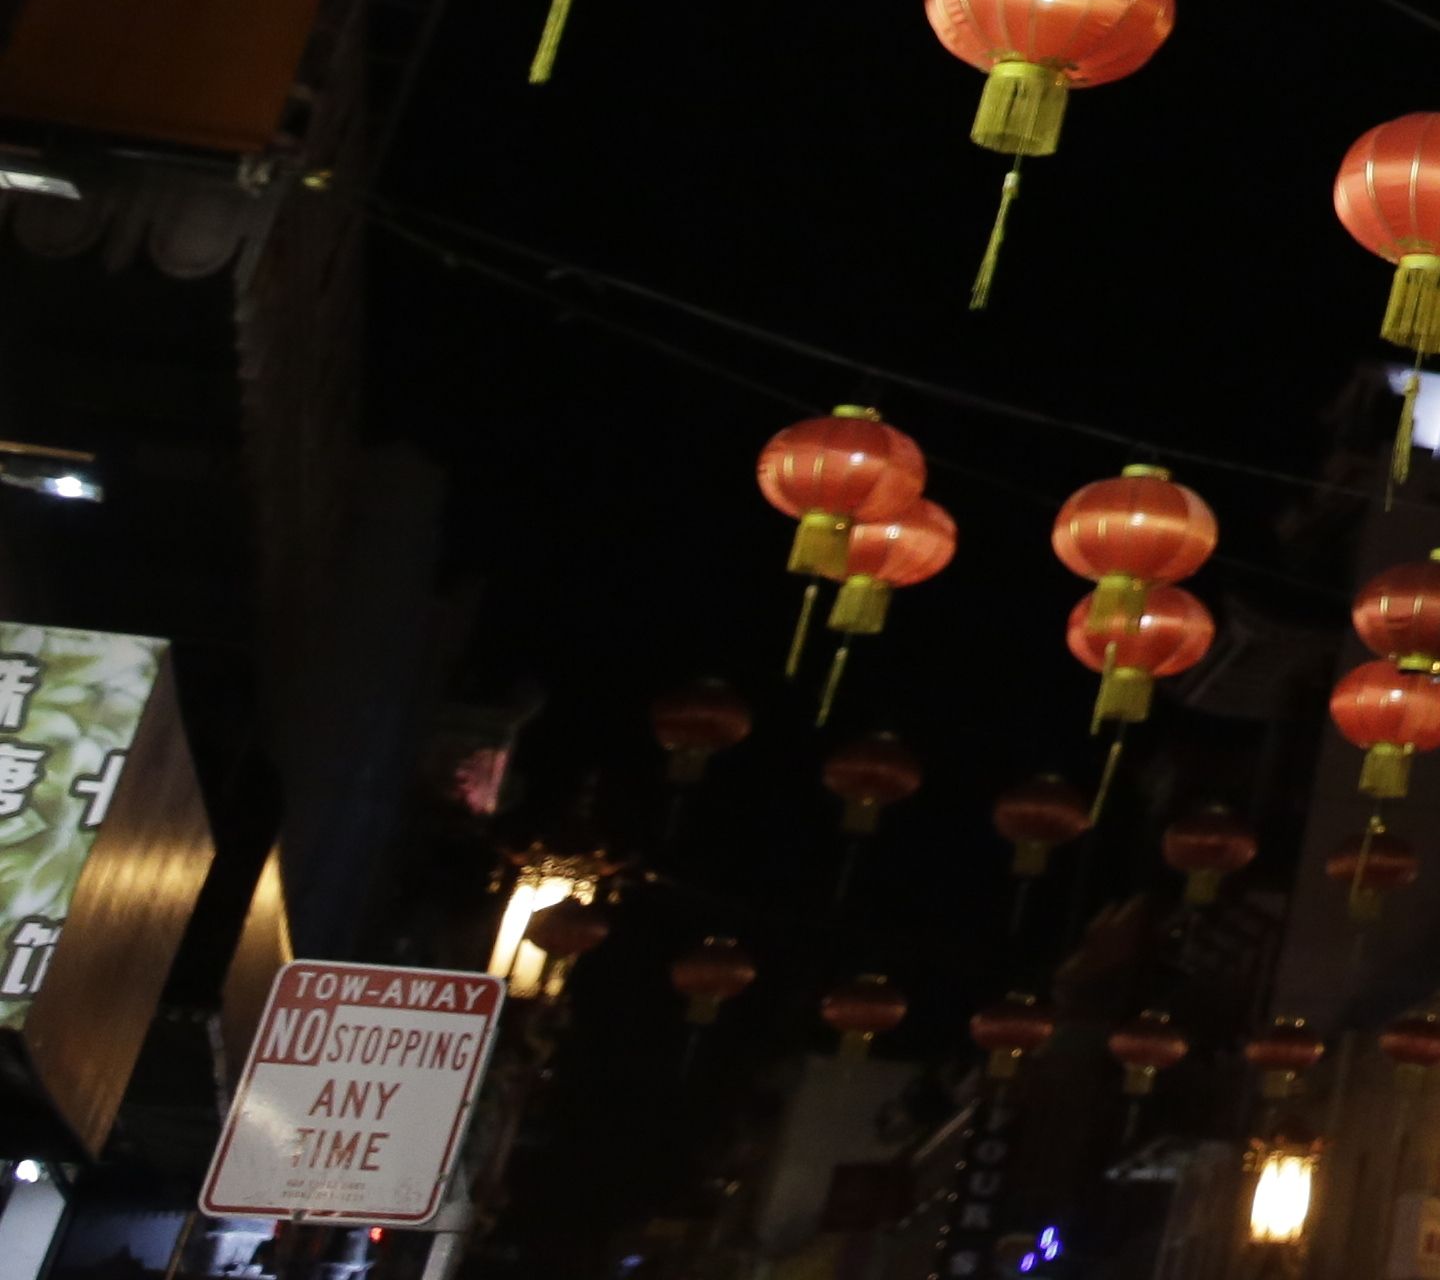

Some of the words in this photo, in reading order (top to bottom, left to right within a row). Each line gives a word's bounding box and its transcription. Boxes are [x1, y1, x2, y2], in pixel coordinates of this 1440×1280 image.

[296, 971, 488, 1011] TOW-AWAY
[262, 1007, 327, 1062] NO
[327, 1023, 473, 1071] STOPPING
[308, 1078, 402, 1120] ANY
[290, 1127, 391, 1170] TIME
